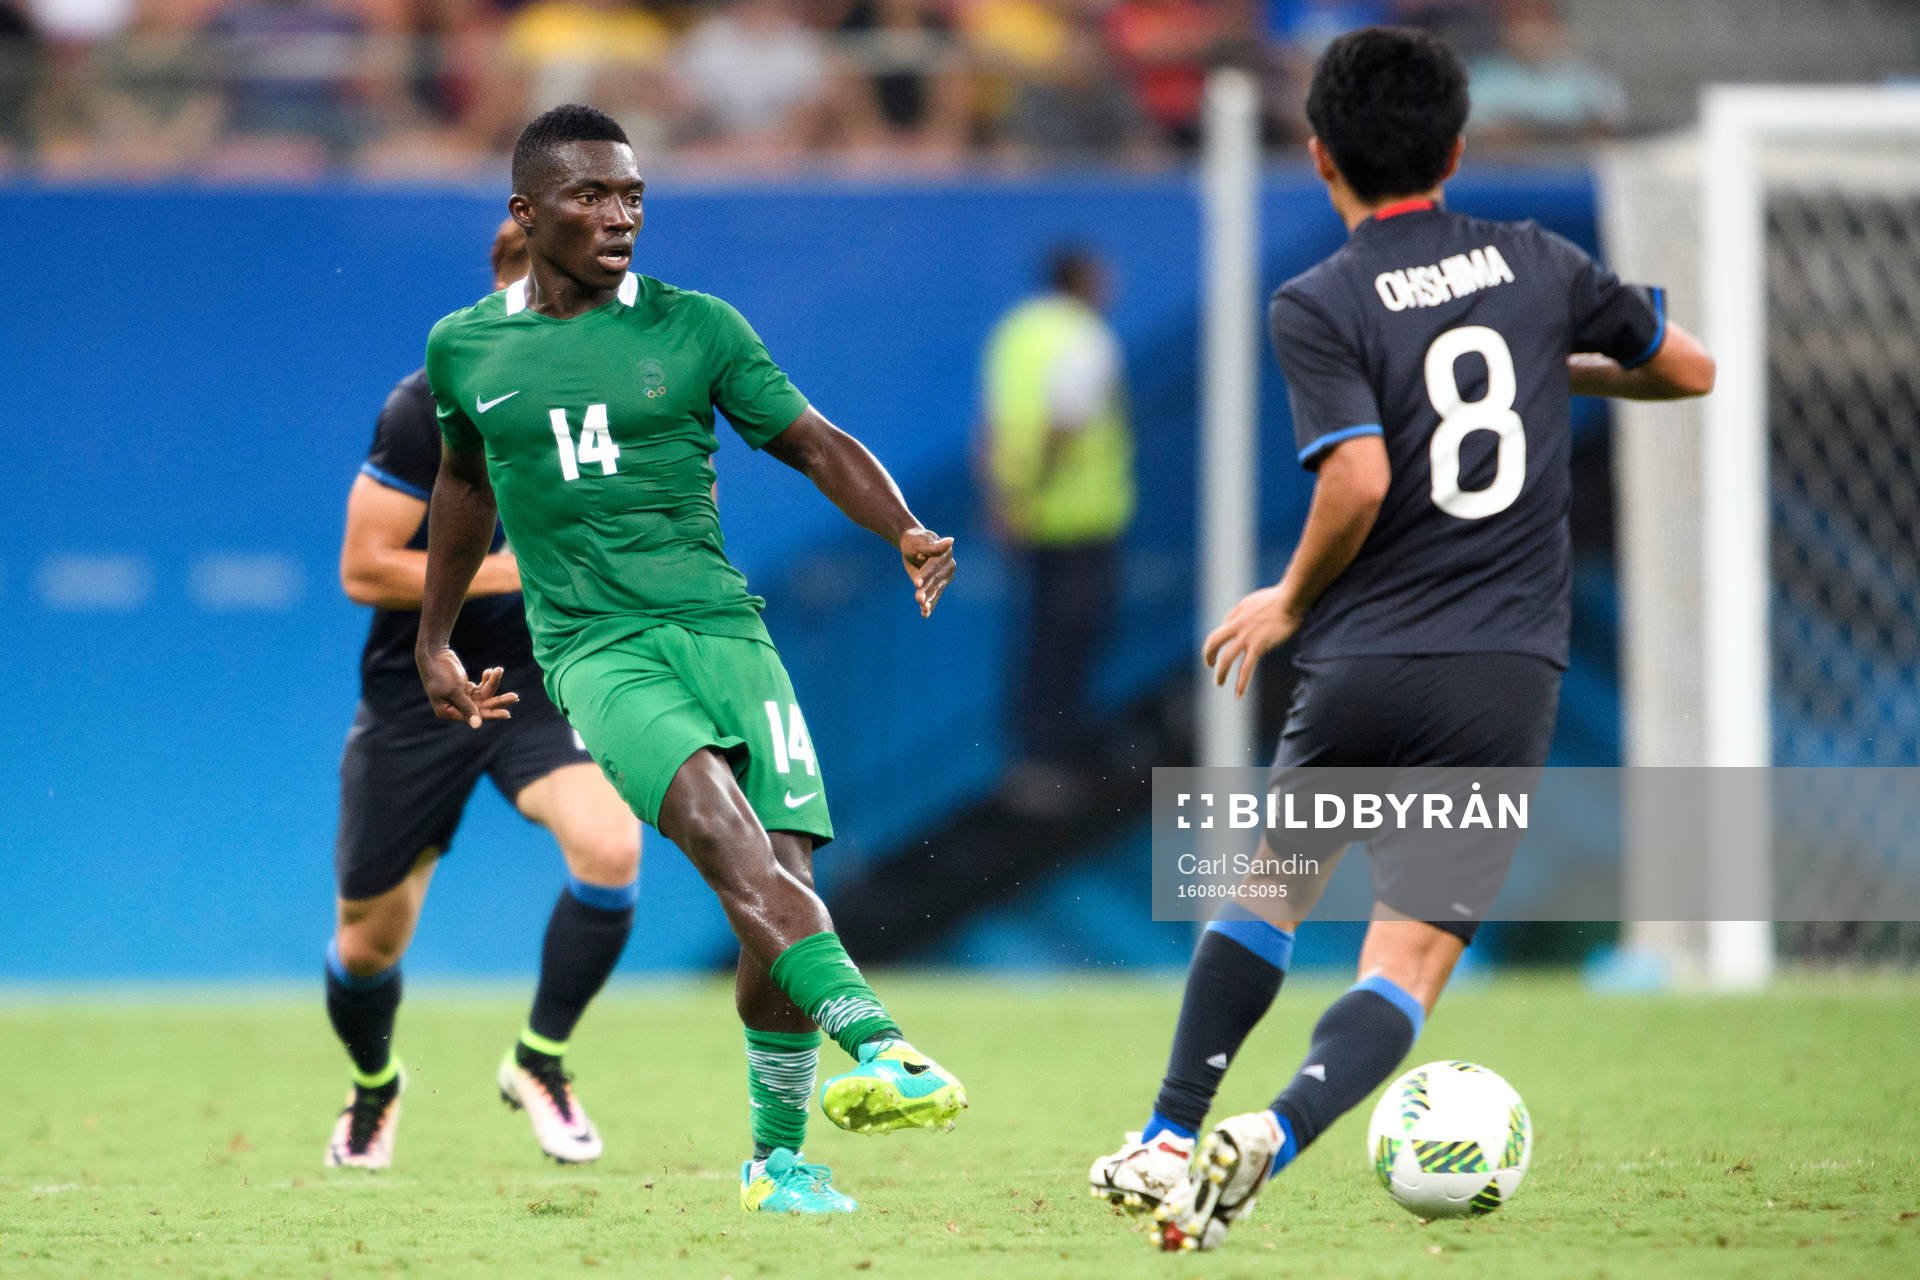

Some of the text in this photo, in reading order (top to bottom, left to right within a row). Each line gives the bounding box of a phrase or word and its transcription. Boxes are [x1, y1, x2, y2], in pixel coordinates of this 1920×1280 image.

[1375, 245, 1515, 312] OHSHIMA
[549, 403, 621, 482] 14
[1424, 325, 1527, 520] 8
[764, 700, 816, 777] 14
